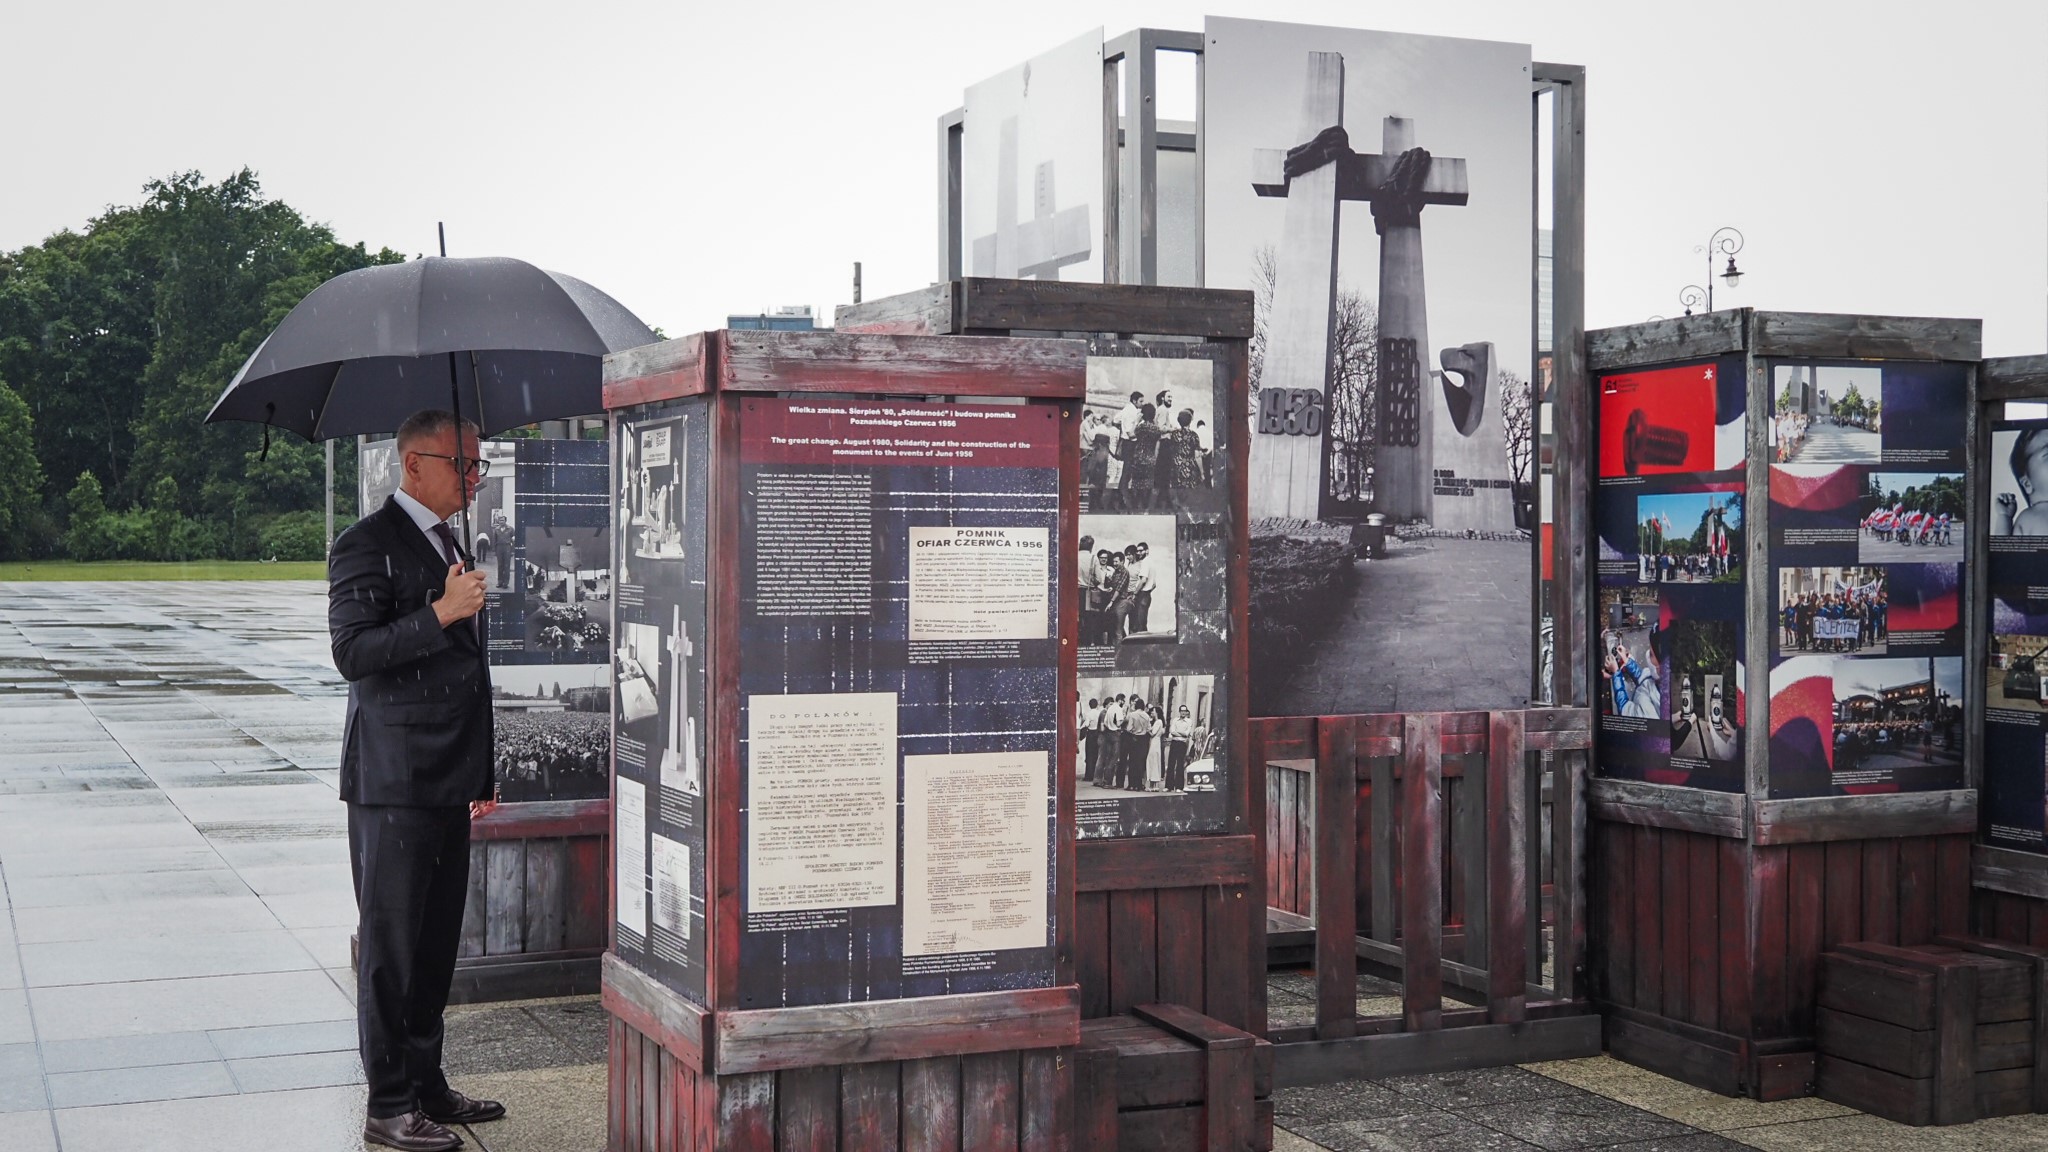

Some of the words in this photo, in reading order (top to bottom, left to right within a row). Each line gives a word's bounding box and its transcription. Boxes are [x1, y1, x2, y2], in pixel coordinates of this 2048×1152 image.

[788, 406, 816, 414] Wielka
[817, 407, 847, 415] zmiana.
[848, 407, 881, 416] Sierpień
[954, 410, 983, 418] budowa
[985, 411, 1017, 419] pomnika
[1258, 387, 1323, 436] 1956
[849, 417, 903, 427] Poznańskiego
[904, 419, 936, 427] Czerwca
[787, 437, 809, 446] great
[810, 437, 841, 446] change.
[842, 438, 870, 447] August
[872, 438, 893, 447] 1980,
[894, 439, 930, 448] Solidarity
[947, 440, 960, 448] the
[1018, 441, 1031, 449] the
[957, 529, 1006, 538] POMNIK
[916, 539, 951, 548] OFIAR
[954, 539, 1012, 547] CZERWCA
[1016, 541, 1043, 549] 1956
[794, 711, 859, 719] POLAKÓW
[689, 780, 698, 792] A
